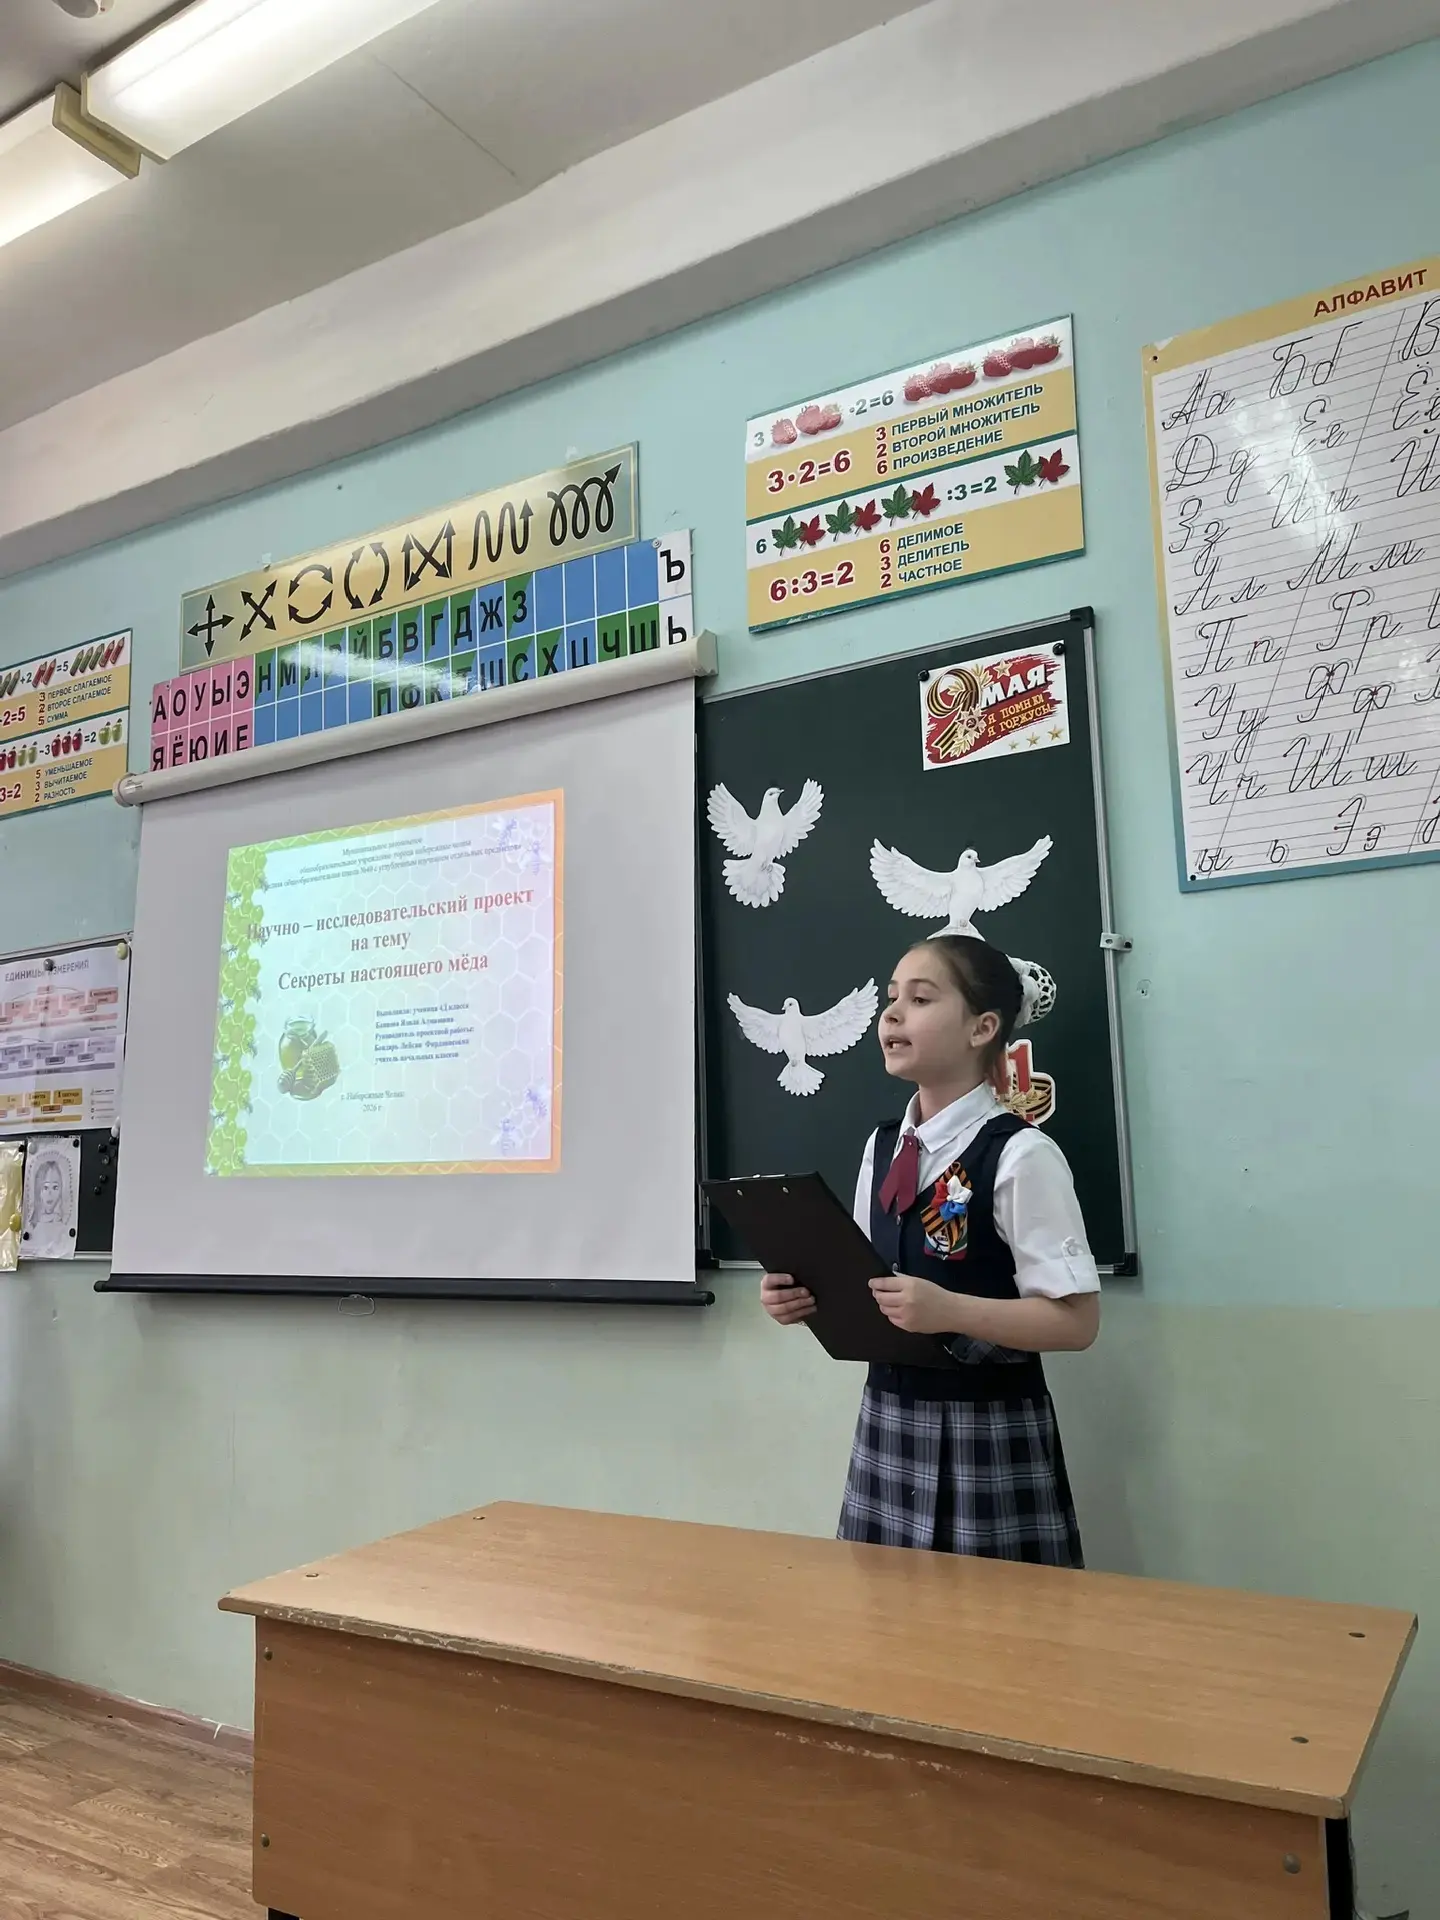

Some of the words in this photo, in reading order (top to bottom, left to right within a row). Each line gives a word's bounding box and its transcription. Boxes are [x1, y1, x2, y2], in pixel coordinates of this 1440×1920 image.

[1314, 269, 1427, 317] АЛФАВИТ
[875, 427, 887, 441] 3
[891, 409, 949, 437] ПЕРВЫЙ
[952, 383, 1044, 422] МНОЖИТЕЛЬ
[753, 431, 765, 447] 3
[876, 443, 888, 458] 2
[892, 428, 947, 454] ВТОРОЙ
[949, 403, 1041, 436] МНОЖИТЕЛЬ
[876, 460, 888, 475] 6
[892, 430, 1004, 471] ПРОИЗВЕДЕНИЕ
[755, 538, 767, 555] 6
[879, 539, 891, 553] 6
[896, 522, 964, 551] ДЕЛИМОЕ
[660, 549, 685, 583] Ъ
[879, 556, 891, 571] 3
[897, 540, 970, 569] ДЕЛИТЕЛЬ
[880, 574, 892, 589] 2
[898, 558, 963, 584] ЧАСТНОЕ
[47, 699, 72, 712] ВТОРОЕ
[72, 686, 112, 704] СЛАГАЕМОЕ
[48, 687, 72, 700] ПЕРВОЕ
[73, 674, 112, 692] СЛАГАЕМОЕ
[981, 664, 1047, 708] МАЯ
[47, 711, 69, 723] СУММА
[987, 714, 997, 725] Я
[987, 727, 997, 738] Я
[999, 703, 1051, 732] ГОРЖУСЬ!
[35, 769, 41, 779] 5
[45, 757, 93, 777] УМЕНЬШАЕМОЕ
[35, 781, 41, 791] 3
[44, 771, 88, 788] ВЫЧИТАЕМОЕ
[34, 793, 40, 803] 2
[43, 786, 76, 800] РАЗНОСТЬ
[316, 896, 468, 931] исследовательский
[474, 888, 535, 913] проект
[350, 938, 368, 952] на
[373, 931, 411, 951] тему
[48, 959, 89, 976] ЗМЕРЕНИЯ
[278, 969, 345, 992] Секреты
[350, 958, 443, 984] настоящего
[448, 952, 489, 972] мёда
